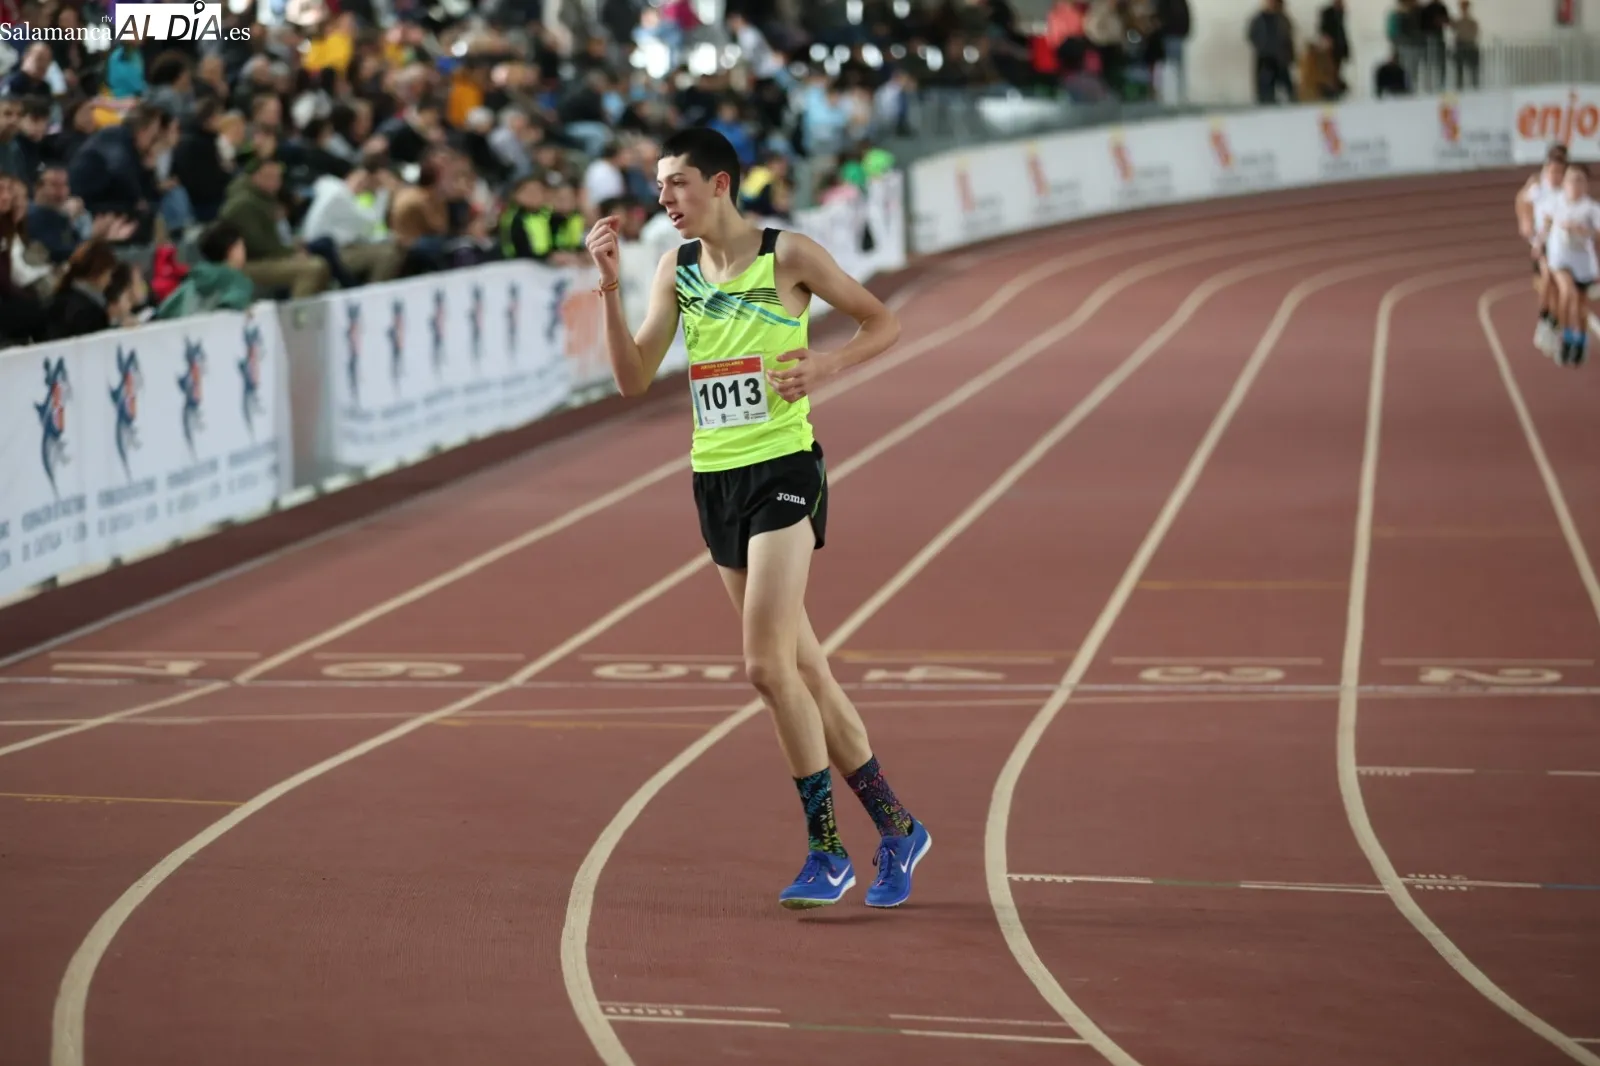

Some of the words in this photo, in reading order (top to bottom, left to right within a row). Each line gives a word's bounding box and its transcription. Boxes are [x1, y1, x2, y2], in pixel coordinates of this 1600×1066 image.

[699, 377, 762, 410] 1013
[1138, 666, 1285, 683] 3
[1418, 666, 1563, 685] 2
